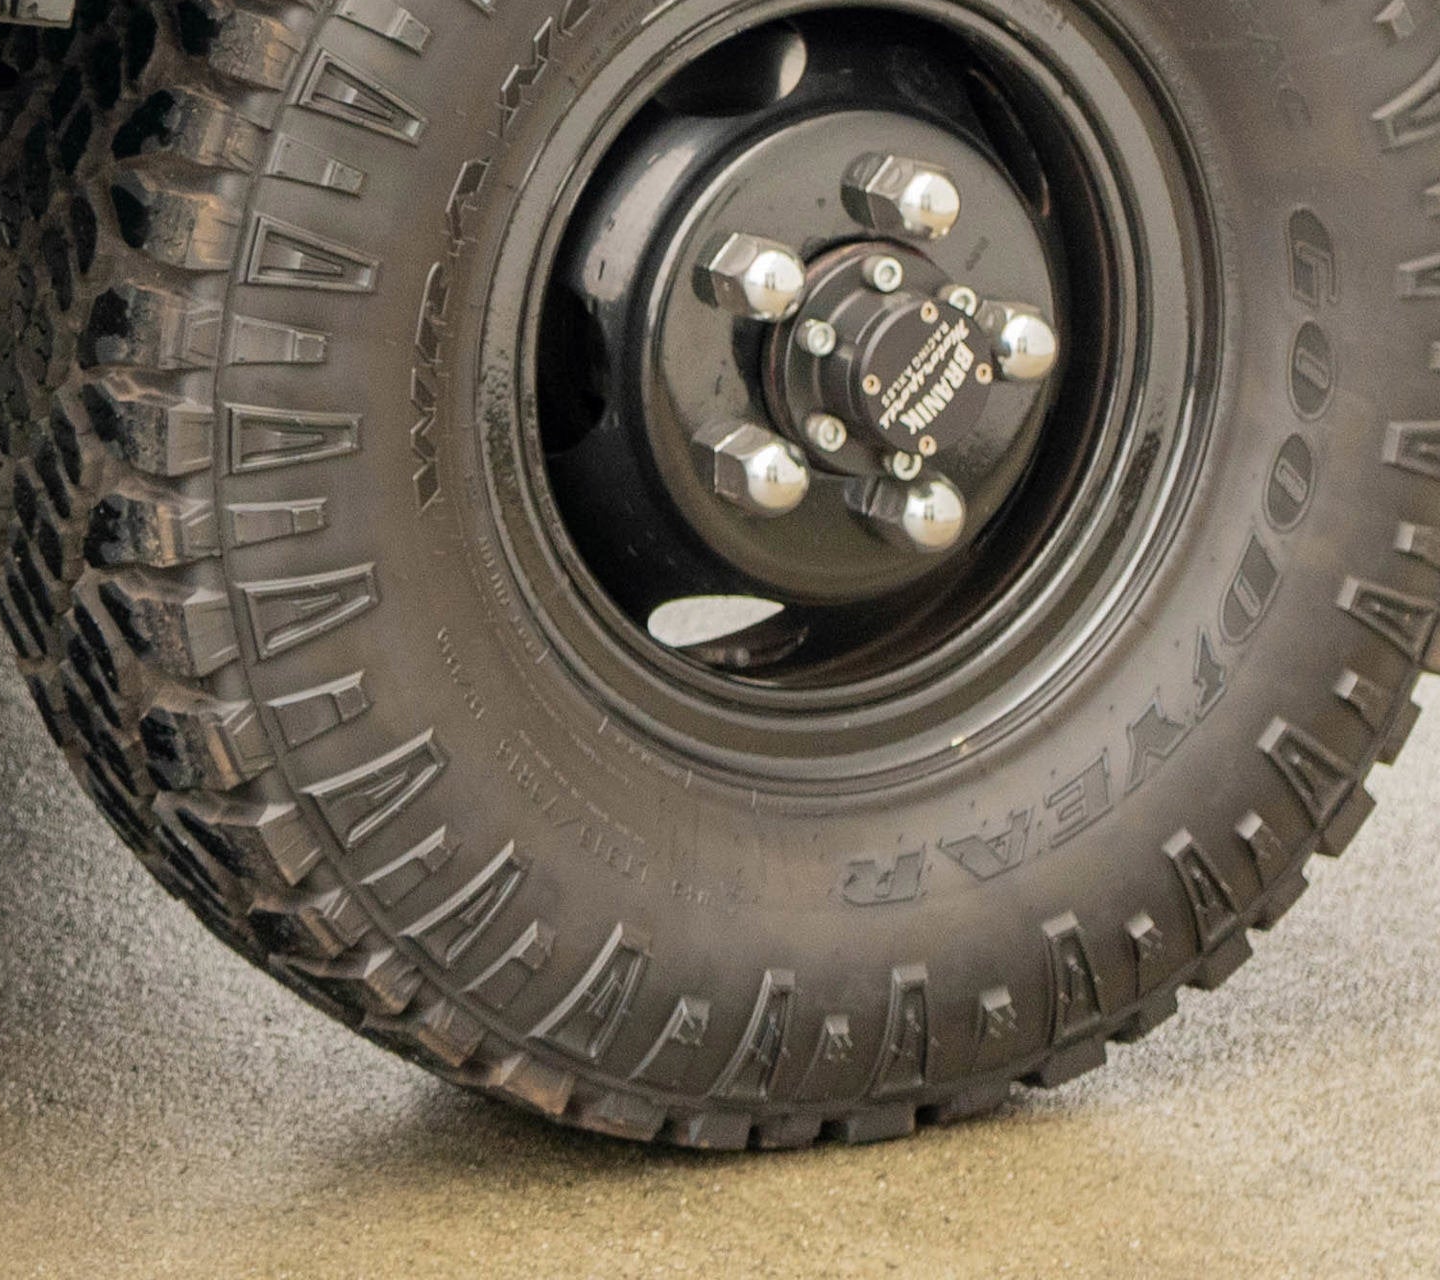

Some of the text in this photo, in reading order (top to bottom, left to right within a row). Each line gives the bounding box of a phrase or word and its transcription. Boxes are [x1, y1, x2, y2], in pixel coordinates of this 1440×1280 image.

[881, 320, 950, 409] RACING AXLES
[899, 339, 974, 436] BRANIK
[841, 206, 1337, 907] GOODYEAR
